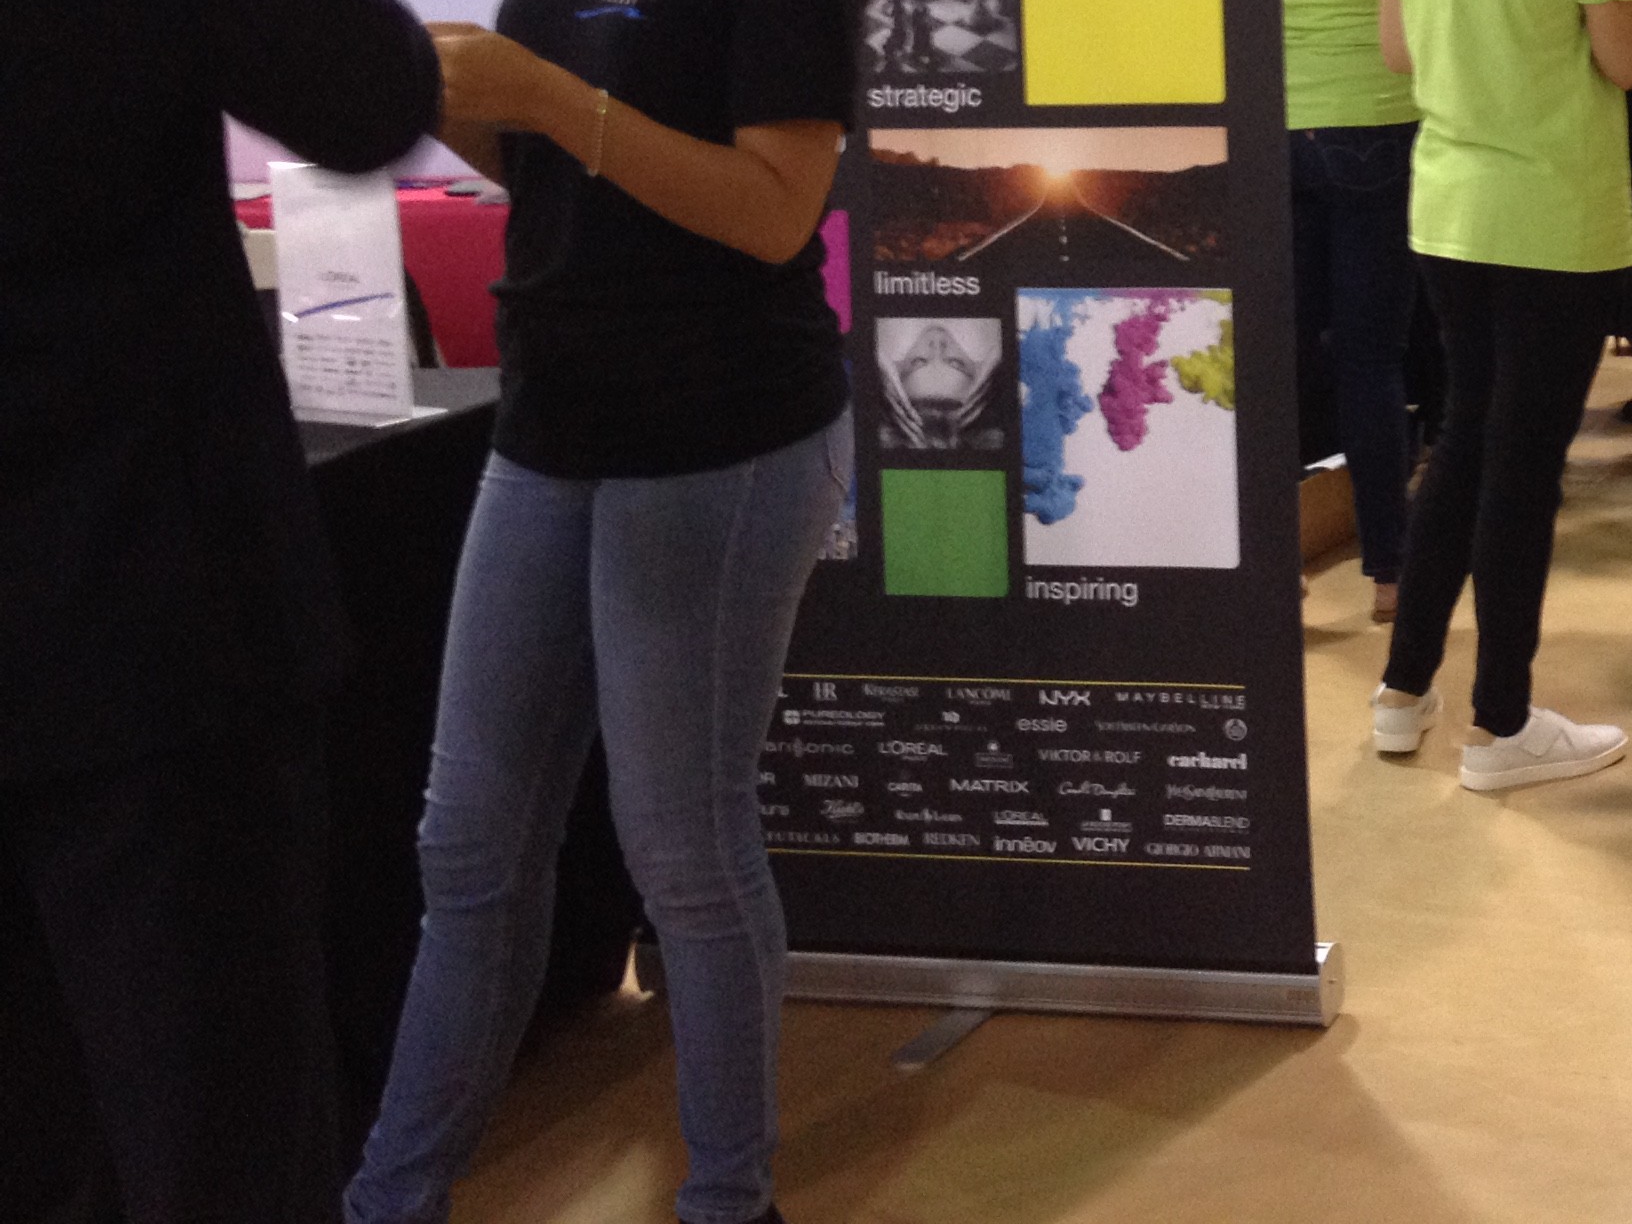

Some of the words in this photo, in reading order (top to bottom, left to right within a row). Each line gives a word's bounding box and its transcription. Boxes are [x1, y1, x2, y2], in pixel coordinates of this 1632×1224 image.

[867, 82, 982, 113] strategic
[873, 270, 981, 296] limitless
[1025, 576, 1139, 607] inspiring
[1038, 689, 1092, 706] NYX
[1115, 692, 1246, 706] MAYBELLINE
[1016, 717, 1068, 733] essie
[1038, 749, 1091, 763] VIKTOR
[1104, 750, 1142, 765] ROLF
[1167, 751, 1248, 770] cacharel
[950, 778, 1030, 794] MATRIX
[1163, 814, 1250, 829] DERMABLEND
[1071, 836, 1130, 853] VICHY
